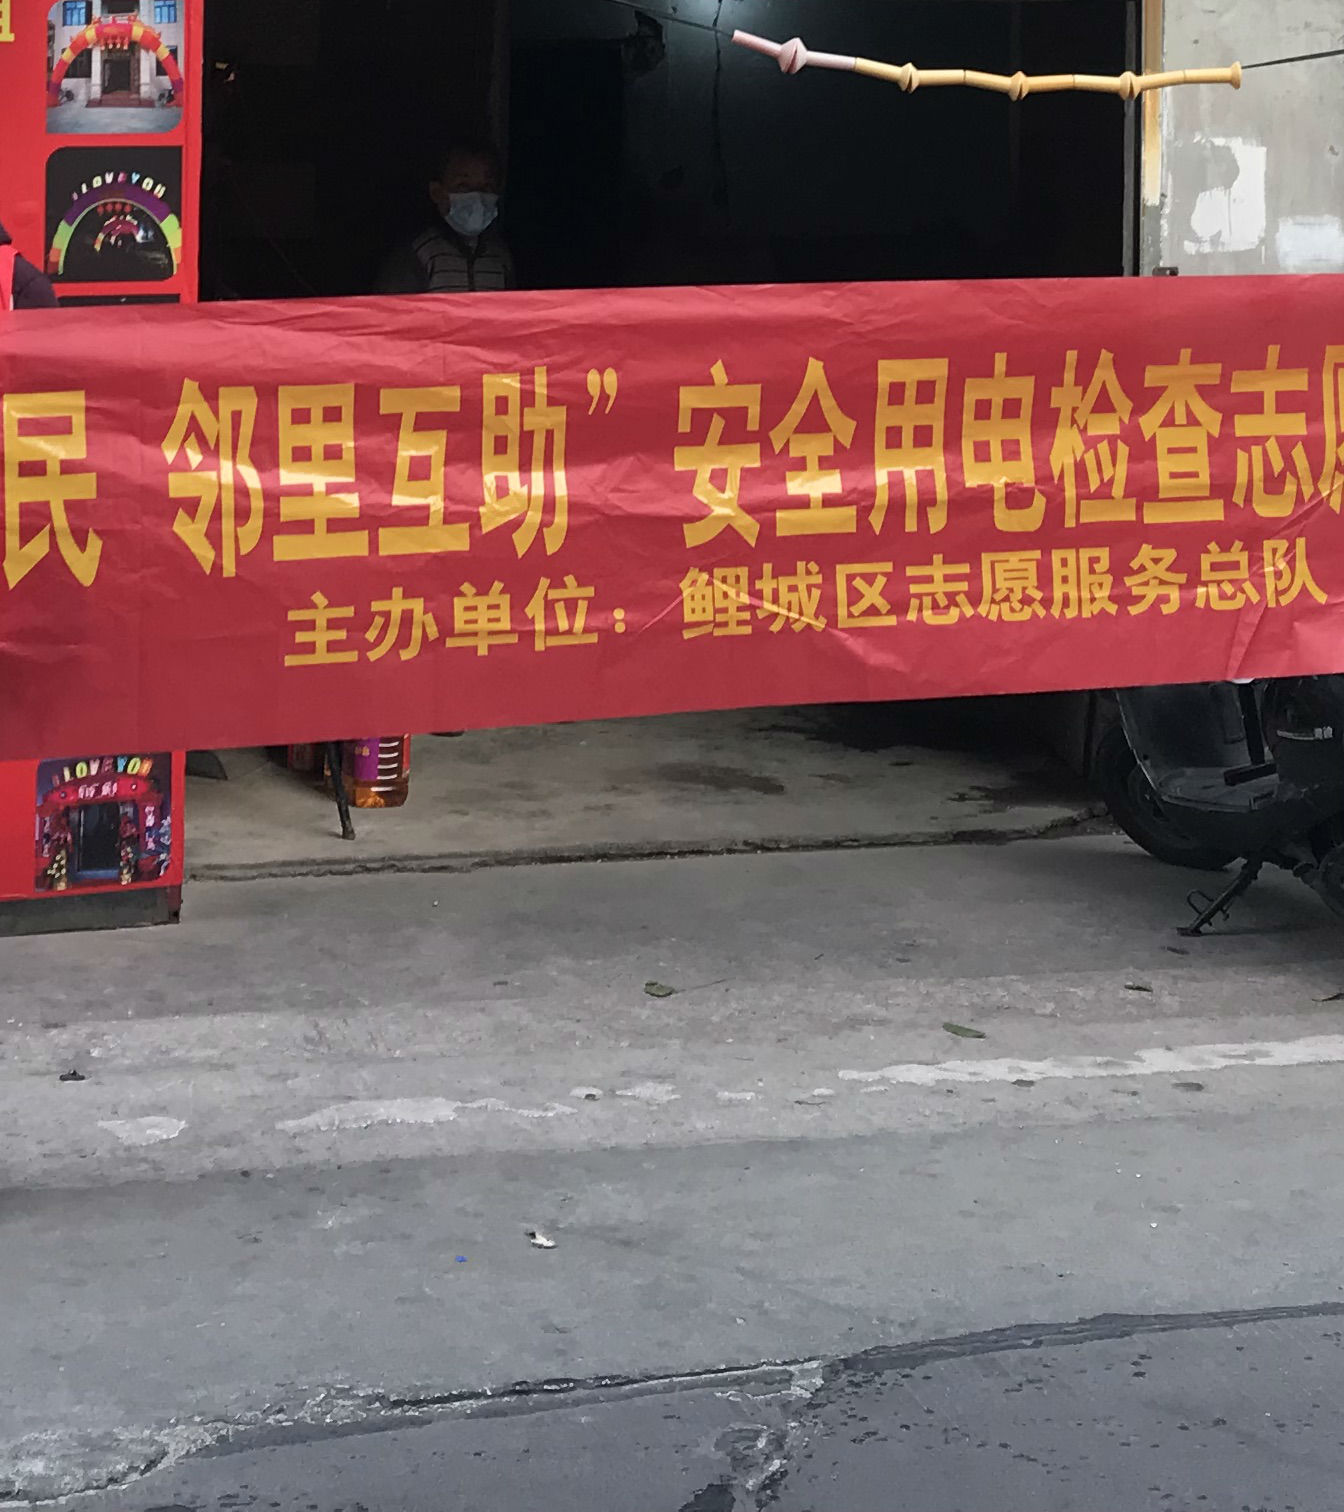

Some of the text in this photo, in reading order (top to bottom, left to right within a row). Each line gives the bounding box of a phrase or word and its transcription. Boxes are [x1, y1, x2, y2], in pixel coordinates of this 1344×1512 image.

[678, 536, 1329, 640] 鲤城区志愿服务总队
